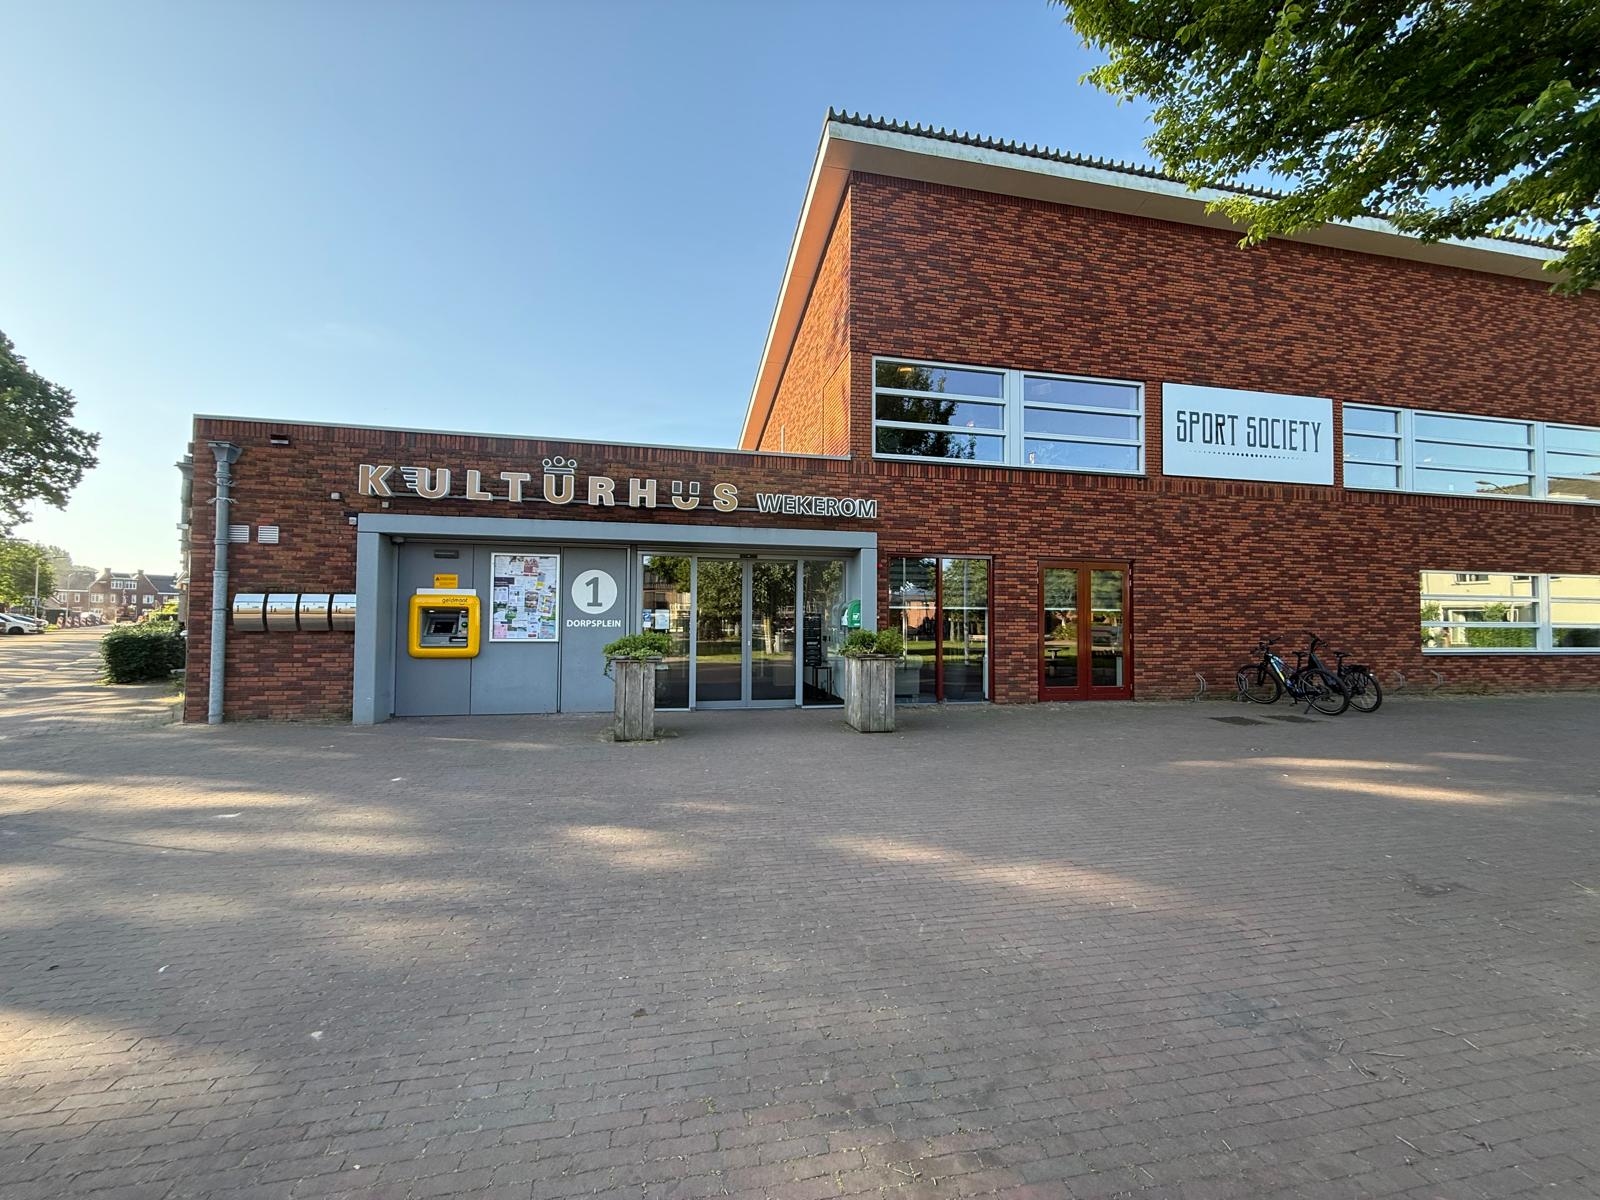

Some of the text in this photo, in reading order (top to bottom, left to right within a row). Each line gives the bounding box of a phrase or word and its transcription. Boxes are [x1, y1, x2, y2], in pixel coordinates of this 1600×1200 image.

[1176, 410, 1322, 453] SPORT SOCIETY
[756, 493, 878, 519] WEKEROM
[585, 577, 603, 607] 1
[566, 619, 622, 628] DORPSPLEIN
